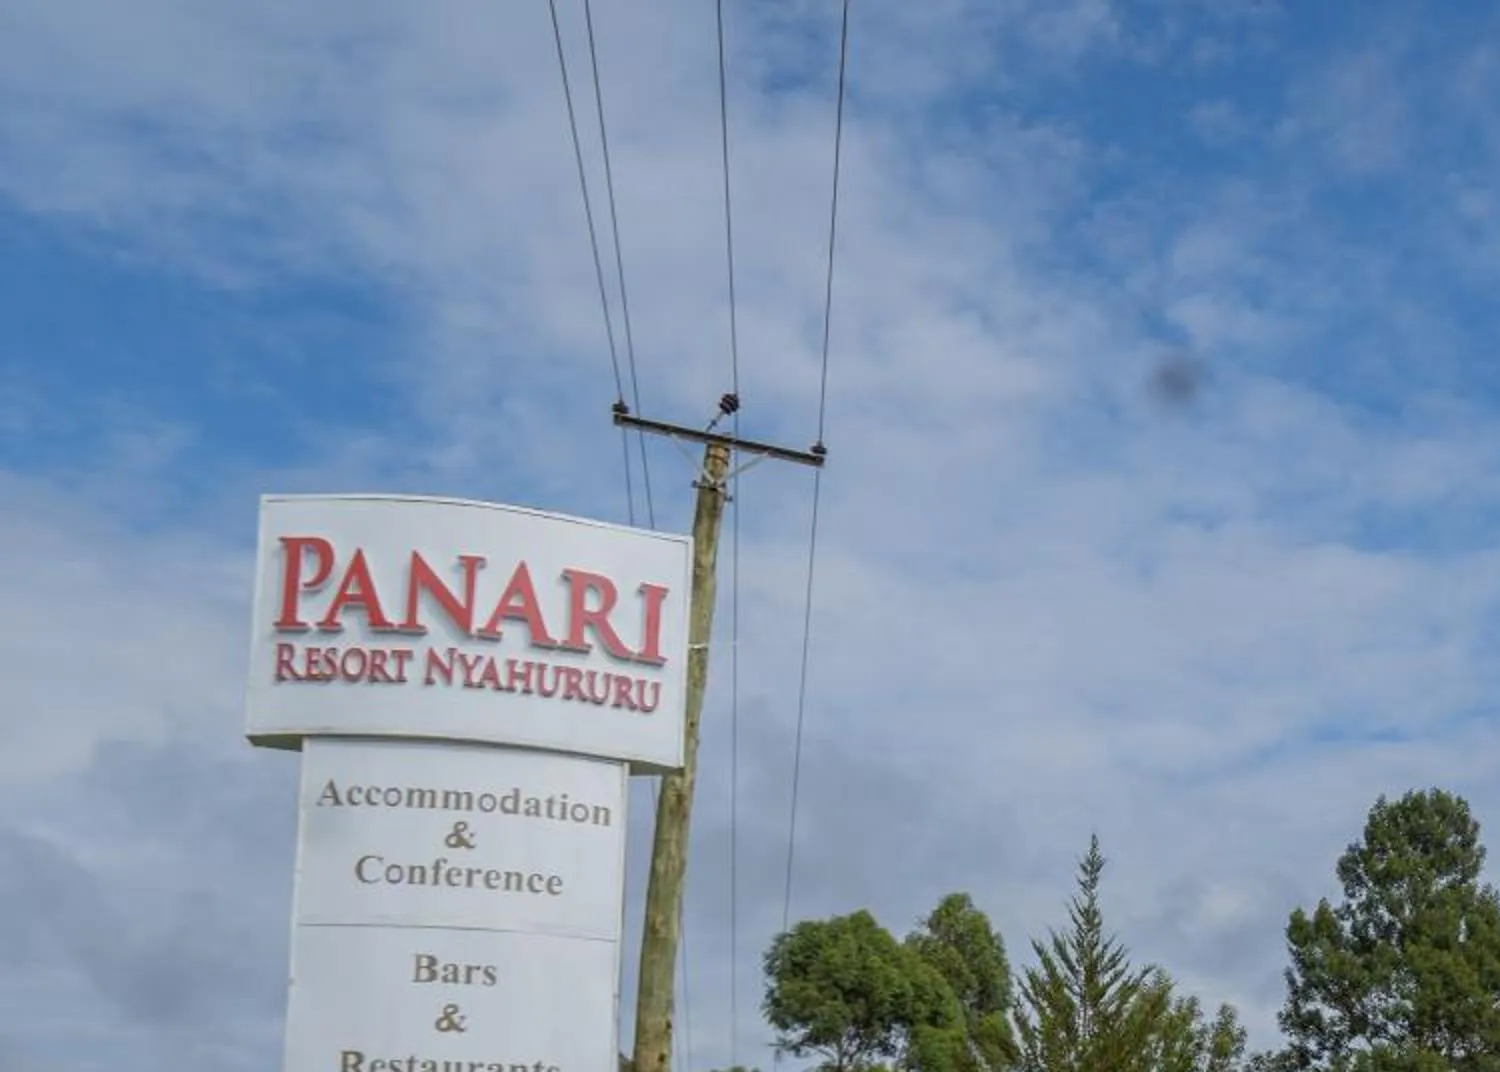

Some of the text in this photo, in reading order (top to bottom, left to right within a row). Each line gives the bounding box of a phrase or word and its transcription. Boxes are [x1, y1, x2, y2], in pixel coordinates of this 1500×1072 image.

[273, 536, 669, 667] PANARI
[274, 642, 663, 714] RESORT NYAHURURU
[316, 778, 612, 827] Accommodation
[444, 821, 476, 850] &
[355, 855, 563, 895] Conference
[412, 953, 498, 987] Bars
[434, 1003, 467, 1033] &
